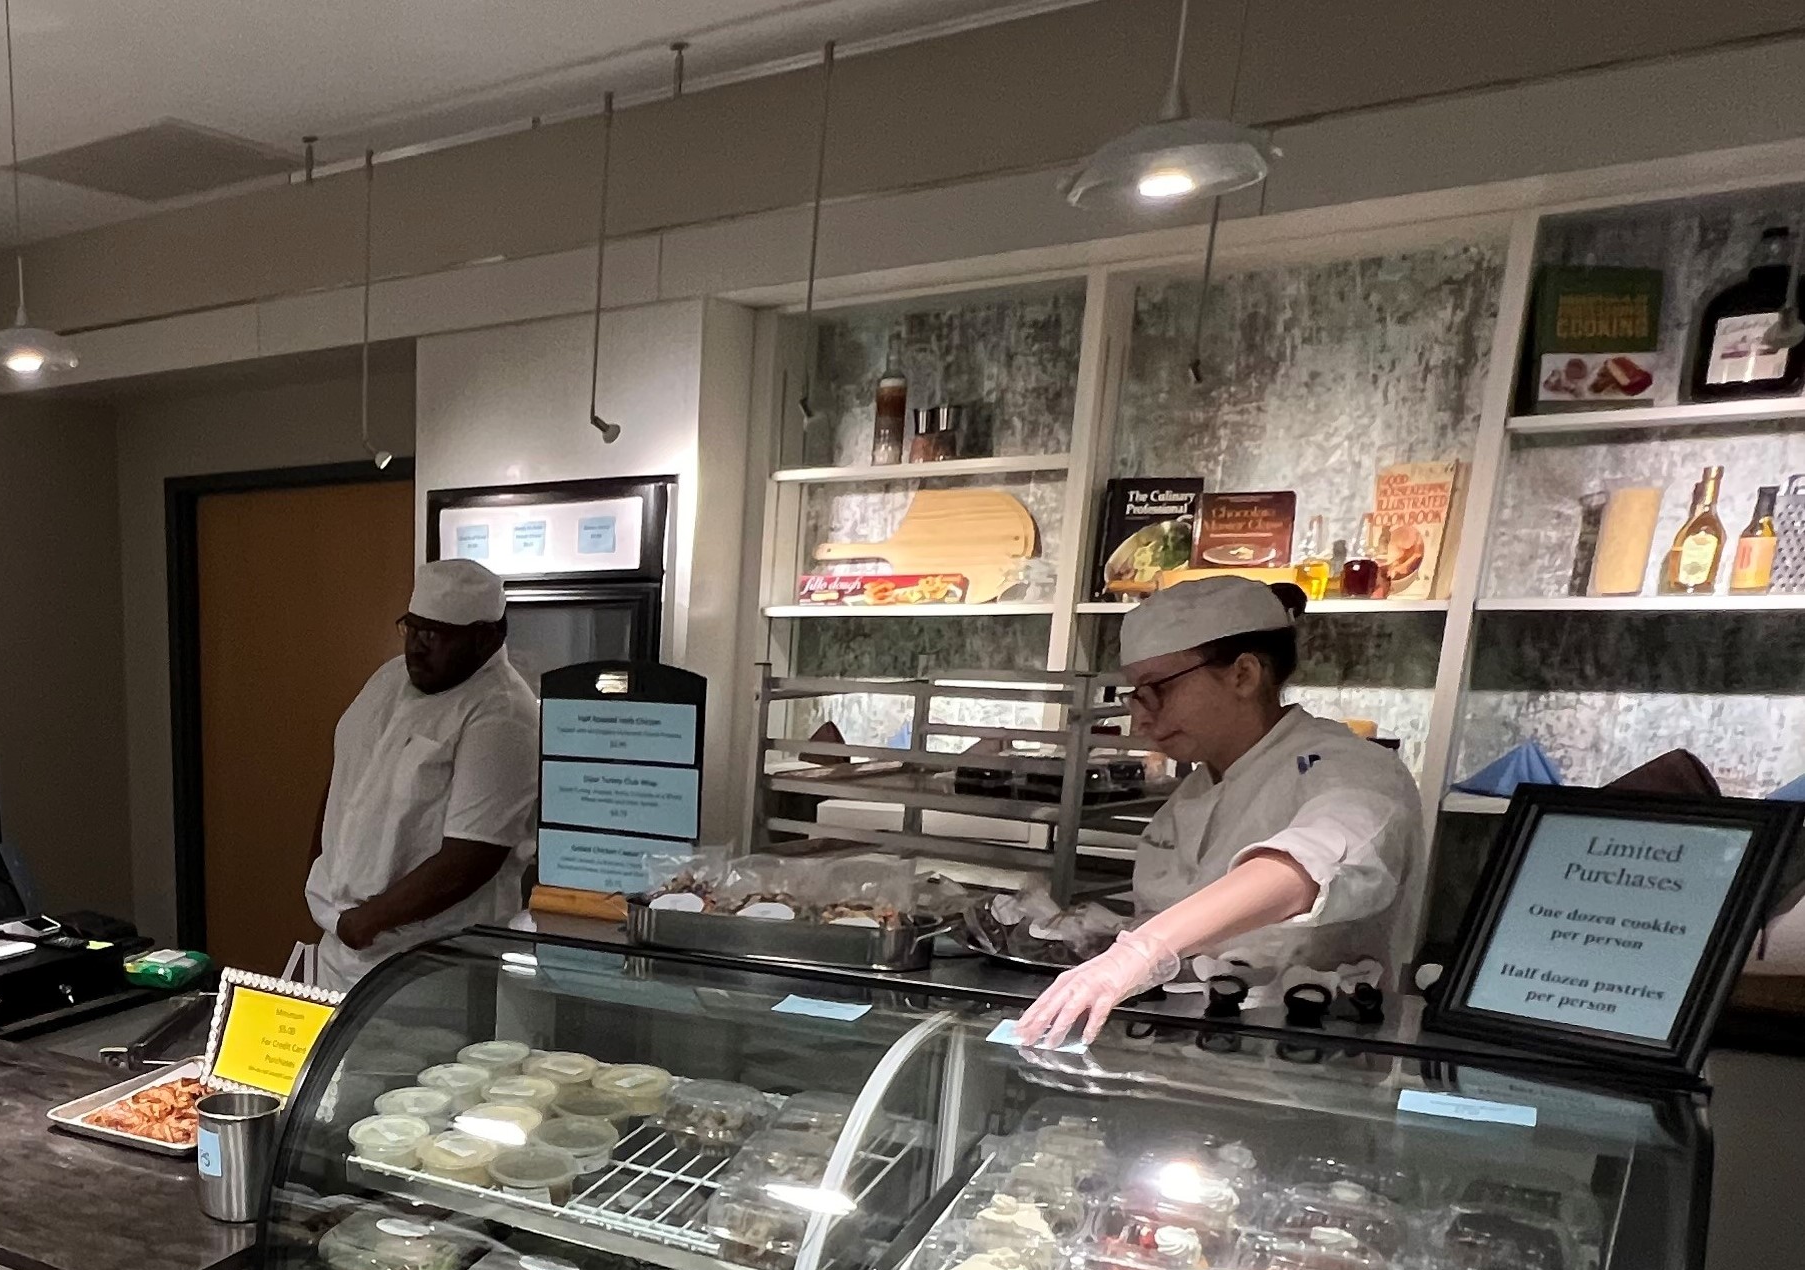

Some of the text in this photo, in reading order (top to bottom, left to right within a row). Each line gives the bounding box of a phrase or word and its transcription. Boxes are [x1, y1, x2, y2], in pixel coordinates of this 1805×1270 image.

[1127, 490, 1196, 504] The Culinary
[1125, 503, 1188, 516] Professional
[1587, 836, 1685, 863] Limited
[1564, 862, 1684, 892] Purchases
[1529, 903, 1687, 936] One dozen cookies
[1550, 929, 1644, 950] per person
[1500, 963, 1666, 1001] Half dozen pastries
[1525, 990, 1618, 1014] per person
[272, 1040, 291, 1052] Credit
[291, 1043, 307, 1055] Card
